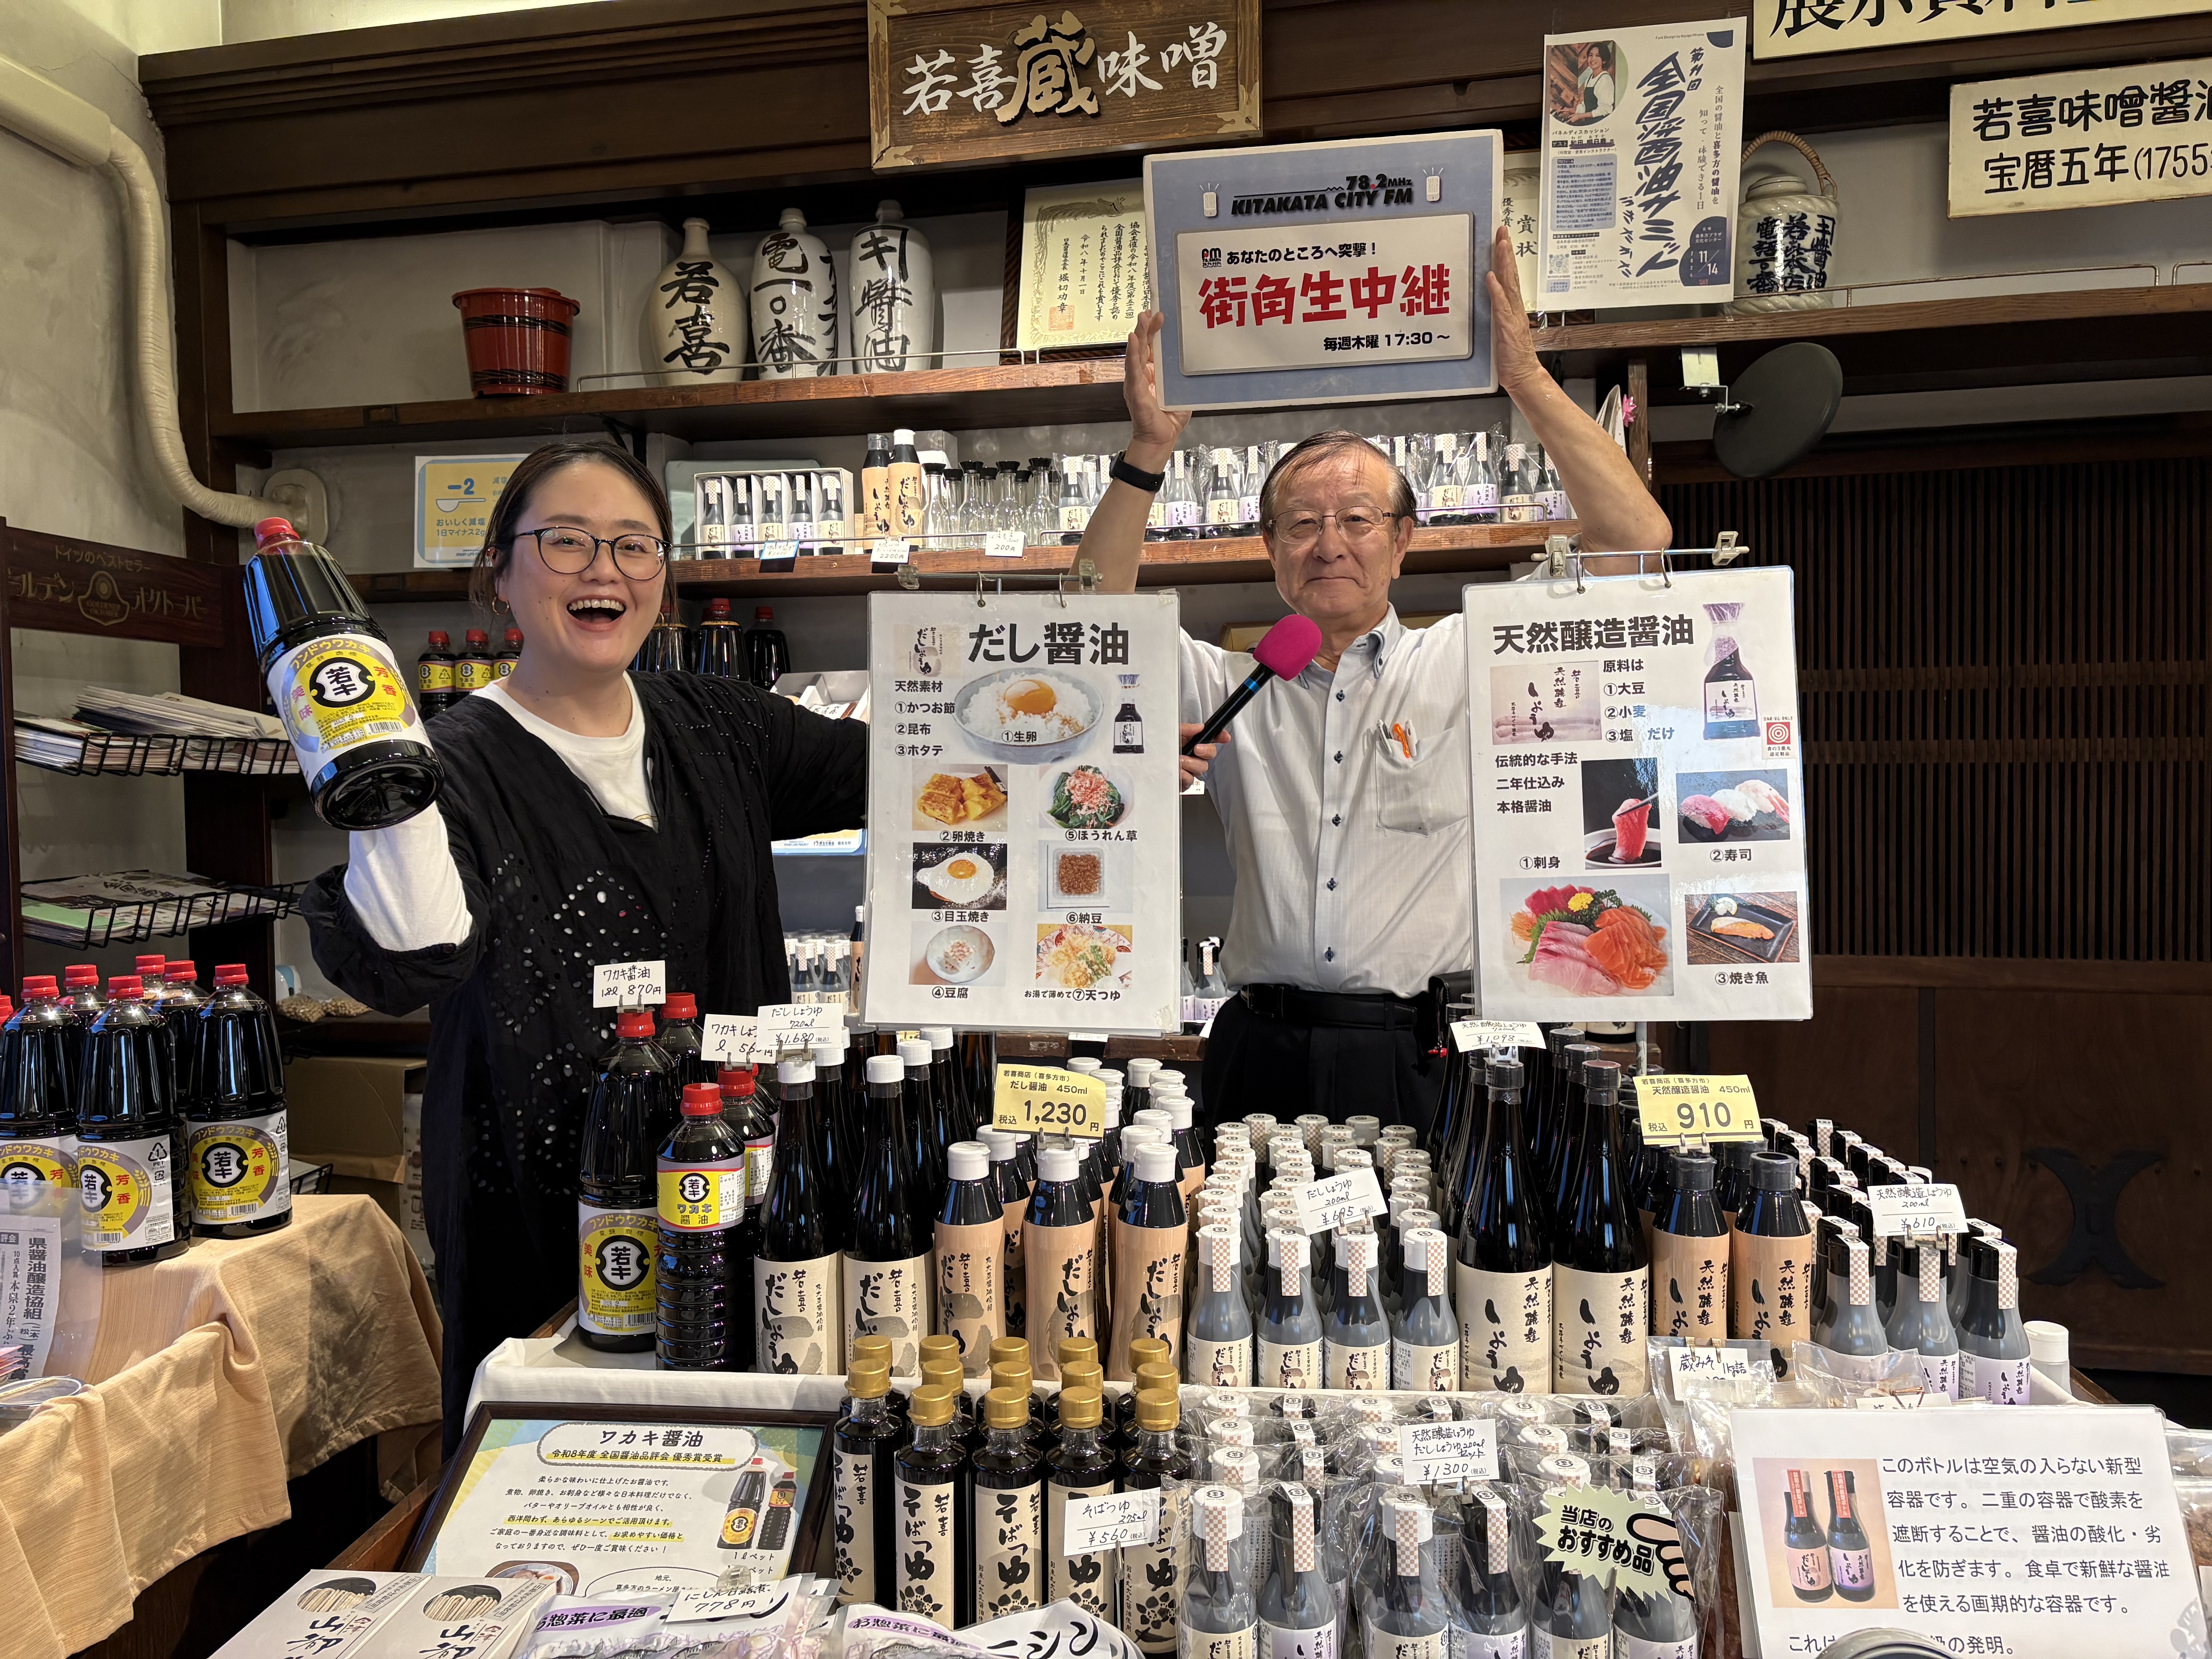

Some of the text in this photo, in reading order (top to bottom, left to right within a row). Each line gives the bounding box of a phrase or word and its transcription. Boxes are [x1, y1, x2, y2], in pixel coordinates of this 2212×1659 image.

[903, 10, 1227, 123] 若喜蔵味噌
[1711, 85, 1724, 204] 全国の醤油と喜多方の醤油を
[1635, 50, 1686, 278] 全国醤油サミット
[1985, 142, 2212, 194] 宝暦五年(1755
[1346, 174, 1412, 191] 78.2MHz
[1231, 188, 1412, 215] KITAKATA CITY FM
[1515, 215, 1538, 257] 賞状
[1226, 242, 1376, 265] あなたのところへ突撃！
[1199, 263, 1450, 329] 街角生中継
[660, 261, 730, 375] 若喜
[1323, 334, 1379, 351] 毎週木曜
[436, 518, 486, 526] おいしく減塩
[968, 621, 1129, 665] だし醤油
[1493, 614, 1694, 655] 天然醸造醤油
[290, 639, 371, 669] フンドウワカキ
[1602, 659, 1644, 673] 原料は
[325, 666, 358, 696] 若キ
[373, 666, 397, 696] 芳香
[894, 680, 943, 693] 天然素材
[1553, 667, 1567, 708] 天然醸造
[1603, 682, 1645, 696] ①大豆
[292, 685, 313, 721] 美味
[894, 701, 955, 714] ①かつお節
[1528, 682, 1554, 742] しょうゆ
[1604, 704, 1646, 720] ②小麦
[894, 723, 931, 735] ②昆布
[1001, 730, 1037, 742] ①生卵
[1605, 726, 1675, 743] ③塩 だけ
[894, 745, 943, 756] ③ホタテ
[1495, 752, 1578, 768] 伝統的な手法
[1496, 776, 1565, 790] 二年仕込み
[1497, 799, 1552, 813] 本格醤油
[939, 830, 986, 843] ②卵焼き
[1065, 830, 1138, 842] ⑤ほうれん草
[1520, 855, 1561, 870] ①刺身
[1710, 848, 1752, 862] ②寿司
[931, 910, 989, 922] ③目玉焼き
[1066, 912, 1103, 924] ⑥納豆
[603, 965, 650, 981] ワカキ醤油
[1715, 972, 1769, 986] ③焼き魚
[628, 984, 662, 996] 870円
[932, 986, 969, 999] ④豆腐
[772, 1006, 822, 1017] だししょうゆ
[790, 1018, 814, 1029] 720ml
[1003, 1070, 1070, 1082] 若喜商店（喜多方市）
[1010, 1080, 1087, 1094] だし醤油 450ml
[1652, 1085, 1709, 1095] 天然醸造醤油
[998, 1099, 1099, 1132] 税込 1,230 円
[1648, 1102, 1754, 1132] 税込 910 円
[194, 1126, 256, 1140] フンドウワカキ
[214, 1151, 232, 1178] 若キ
[252, 1147, 265, 1176] 芳香
[116, 1174, 131, 1204] 芳香
[689, 1179, 700, 1197] 若キ
[1307, 1178, 1352, 1200] だししょうゆ
[1876, 1188, 1952, 1200] 天然醸造しょうゆ
[1325, 1193, 1350, 1207] 200ml
[1901, 1199, 1930, 1209] 200ml
[677, 1204, 712, 1214] ワカキ
[589, 1214, 658, 1230] フンドウワカキ
[584, 1243, 592, 1278] 美味
[611, 1246, 631, 1280] 若キ
[23, 1237, 47, 1320] 県醤油醸造協組
[1697, 1259, 1714, 1326] 天然醸造
[1778, 1260, 1795, 1326] 天然醸造
[1523, 1276, 1540, 1343] 天然醸造
[1618, 1277, 1636, 1344] 天然醸造
[1485, 1298, 1525, 1394] しょうゆ
[1580, 1298, 1620, 1395] しょうゆ
[599, 1429, 704, 1448] ワカキ醤油
[1412, 1427, 1475, 1444] 天然醸造しょうゆ
[551, 1449, 723, 1463] 令和8年度 全国醤油品評会 優秀賞受賞
[1414, 1441, 1461, 1456] だししょうゆ
[1459, 1449, 1484, 1458] セット
[1881, 1456, 2143, 1476] このボトルは空気の入らない新型
[538, 1475, 669, 1487] 柔らかな味わいに仕上げたお醤油です。
[854, 1464, 868, 1505] 若喜
[505, 1488, 692, 1500] 煮物、卵焼き、お刺身など様々な日本料理だけでなく、
[1887, 1490, 2143, 1510] 容器です。二重の容器で酸素を
[524, 1502, 664, 1512] バターやオリーブオイルとも相性が良く、
[934, 1493, 951, 1537] 若喜
[1082, 1500, 1130, 1517] そばつゆ
[507, 1515, 672, 1526] 西洋問わず、あらゆるシーンでご活用頂けます。
[1560, 1505, 1613, 1532] 当店の
[490, 1528, 683, 1540] ご家庭の一番身近な調味料として、お求めやすい価格と
[903, 1485, 936, 1582] そばつゆ
[995, 1493, 1031, 1589] そばつゆ
[1130, 1532, 1146, 1540] (税込)
[1891, 1524, 2161, 1545] 遮断することで、醤油の酸化・劣
[495, 1542, 667, 1553] なっておりますので、ぜひ一度ご賞味ください！
[1558, 1525, 1656, 1575] おすすめ品
[1898, 1558, 2170, 1580] 化を防ぎます。食卓で新鮮な醤油
[695, 1599, 756, 1613] 778円
[1903, 1594, 2129, 1615] を使える画期的な容器です。
